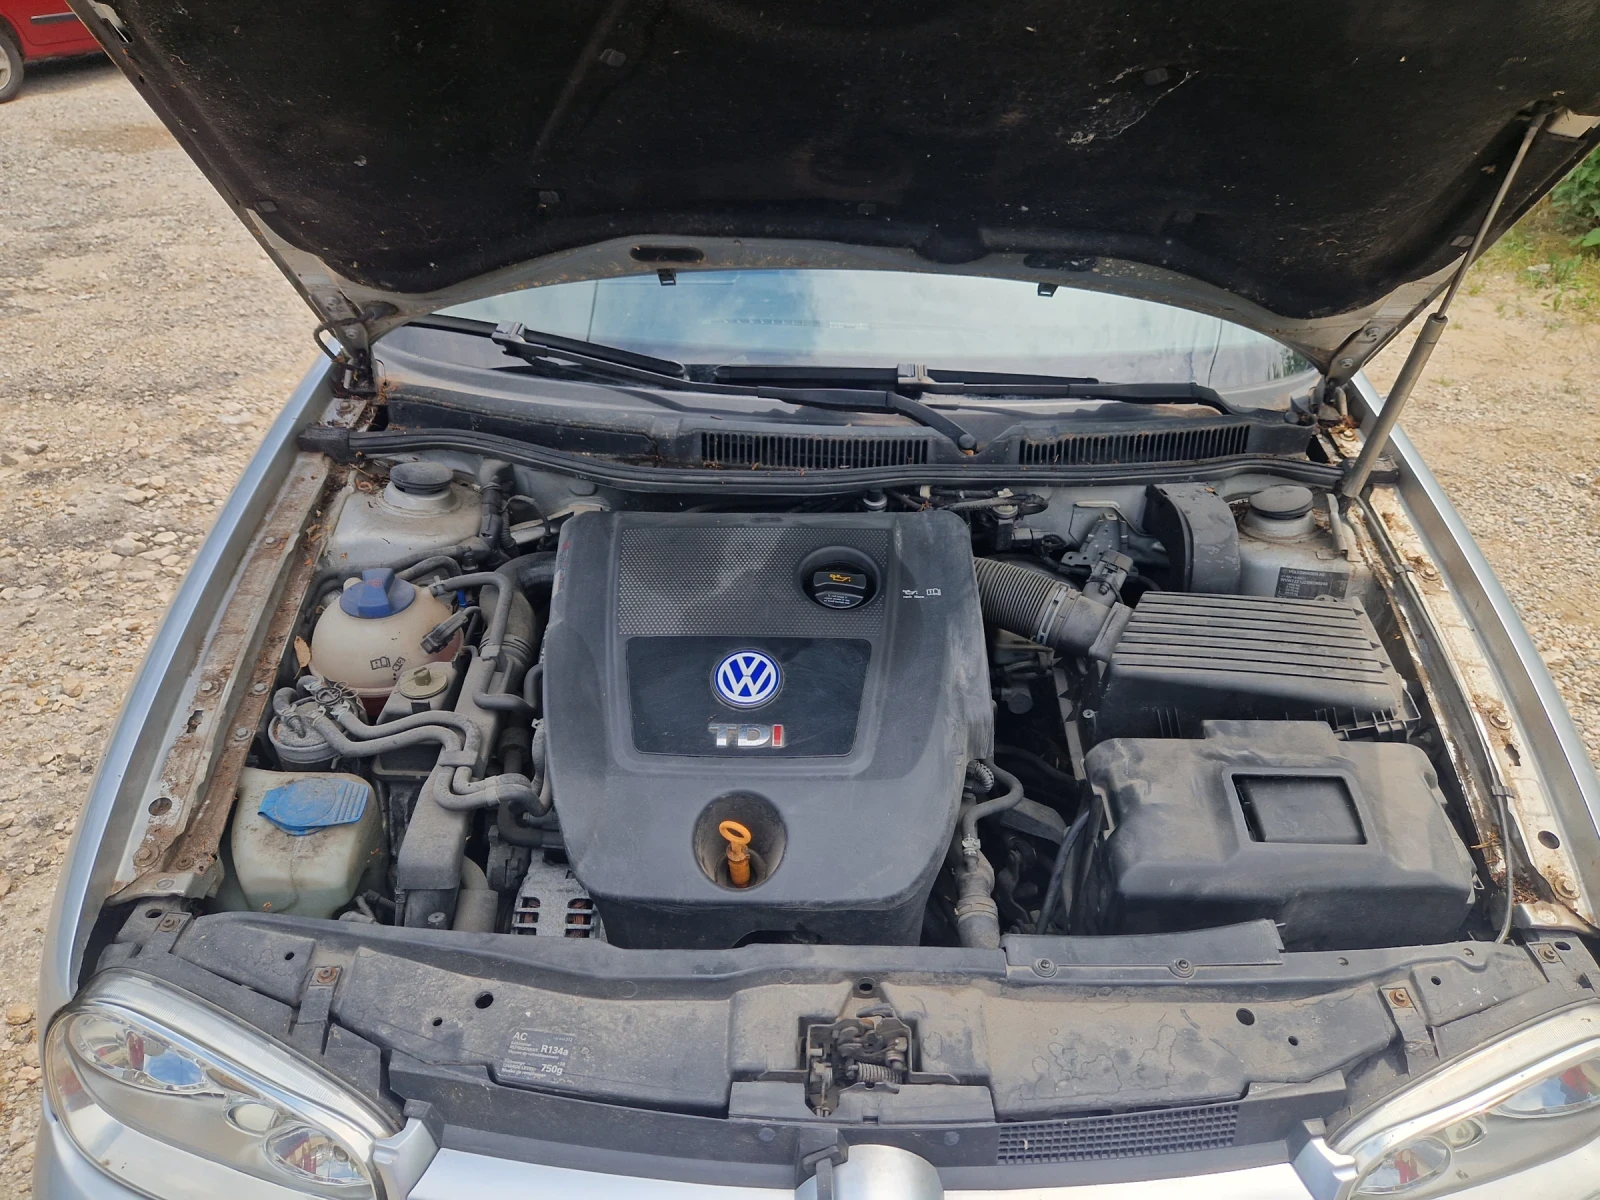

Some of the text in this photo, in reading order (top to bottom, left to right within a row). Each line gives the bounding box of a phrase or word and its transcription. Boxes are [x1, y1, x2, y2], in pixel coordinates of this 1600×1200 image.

[714, 649, 780, 706] VW
[708, 723, 784, 748] TDI
[513, 1032, 528, 1041] AC
[540, 1044, 569, 1056] R134a
[540, 1063, 563, 1076] 750g
